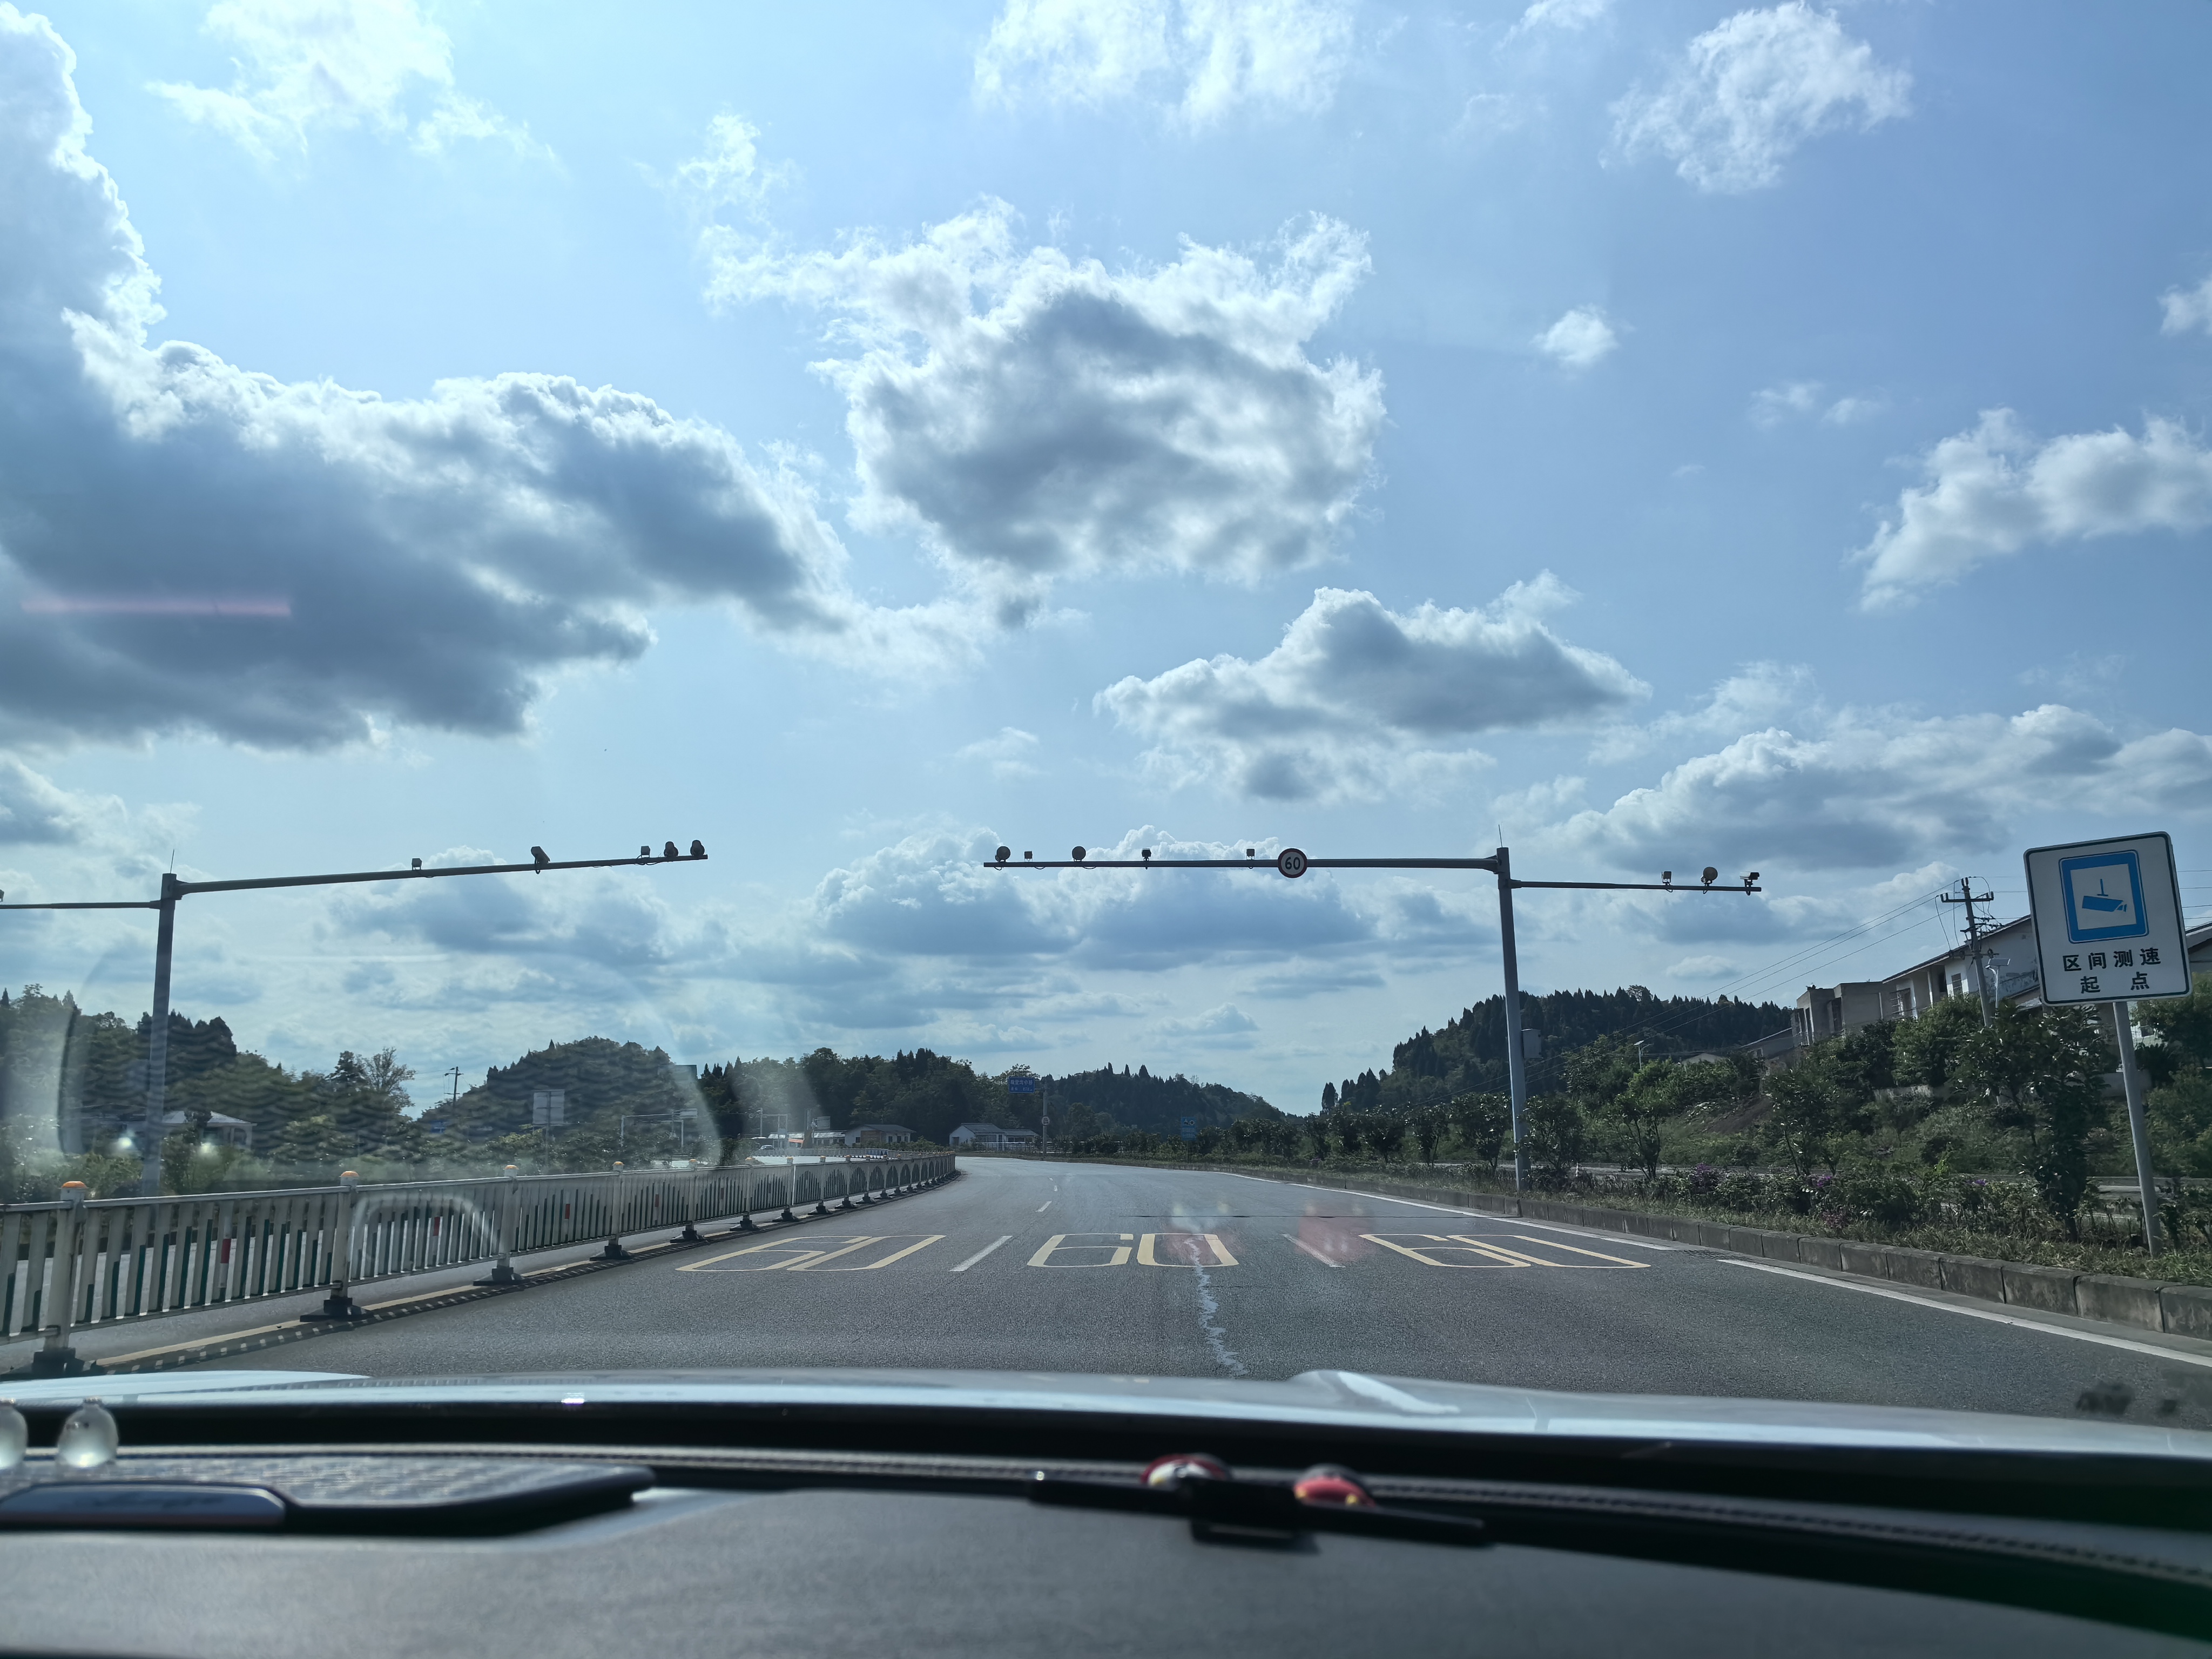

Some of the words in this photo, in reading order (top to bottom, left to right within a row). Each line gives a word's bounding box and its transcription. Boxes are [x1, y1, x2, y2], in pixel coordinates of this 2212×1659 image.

[1285, 857, 1301, 870] 60
[2062, 947, 2161, 972] 区间测速
[675, 1235, 947, 1271] 60
[1027, 1233, 1240, 1267] 60
[1358, 1234, 1651, 1268] 60
